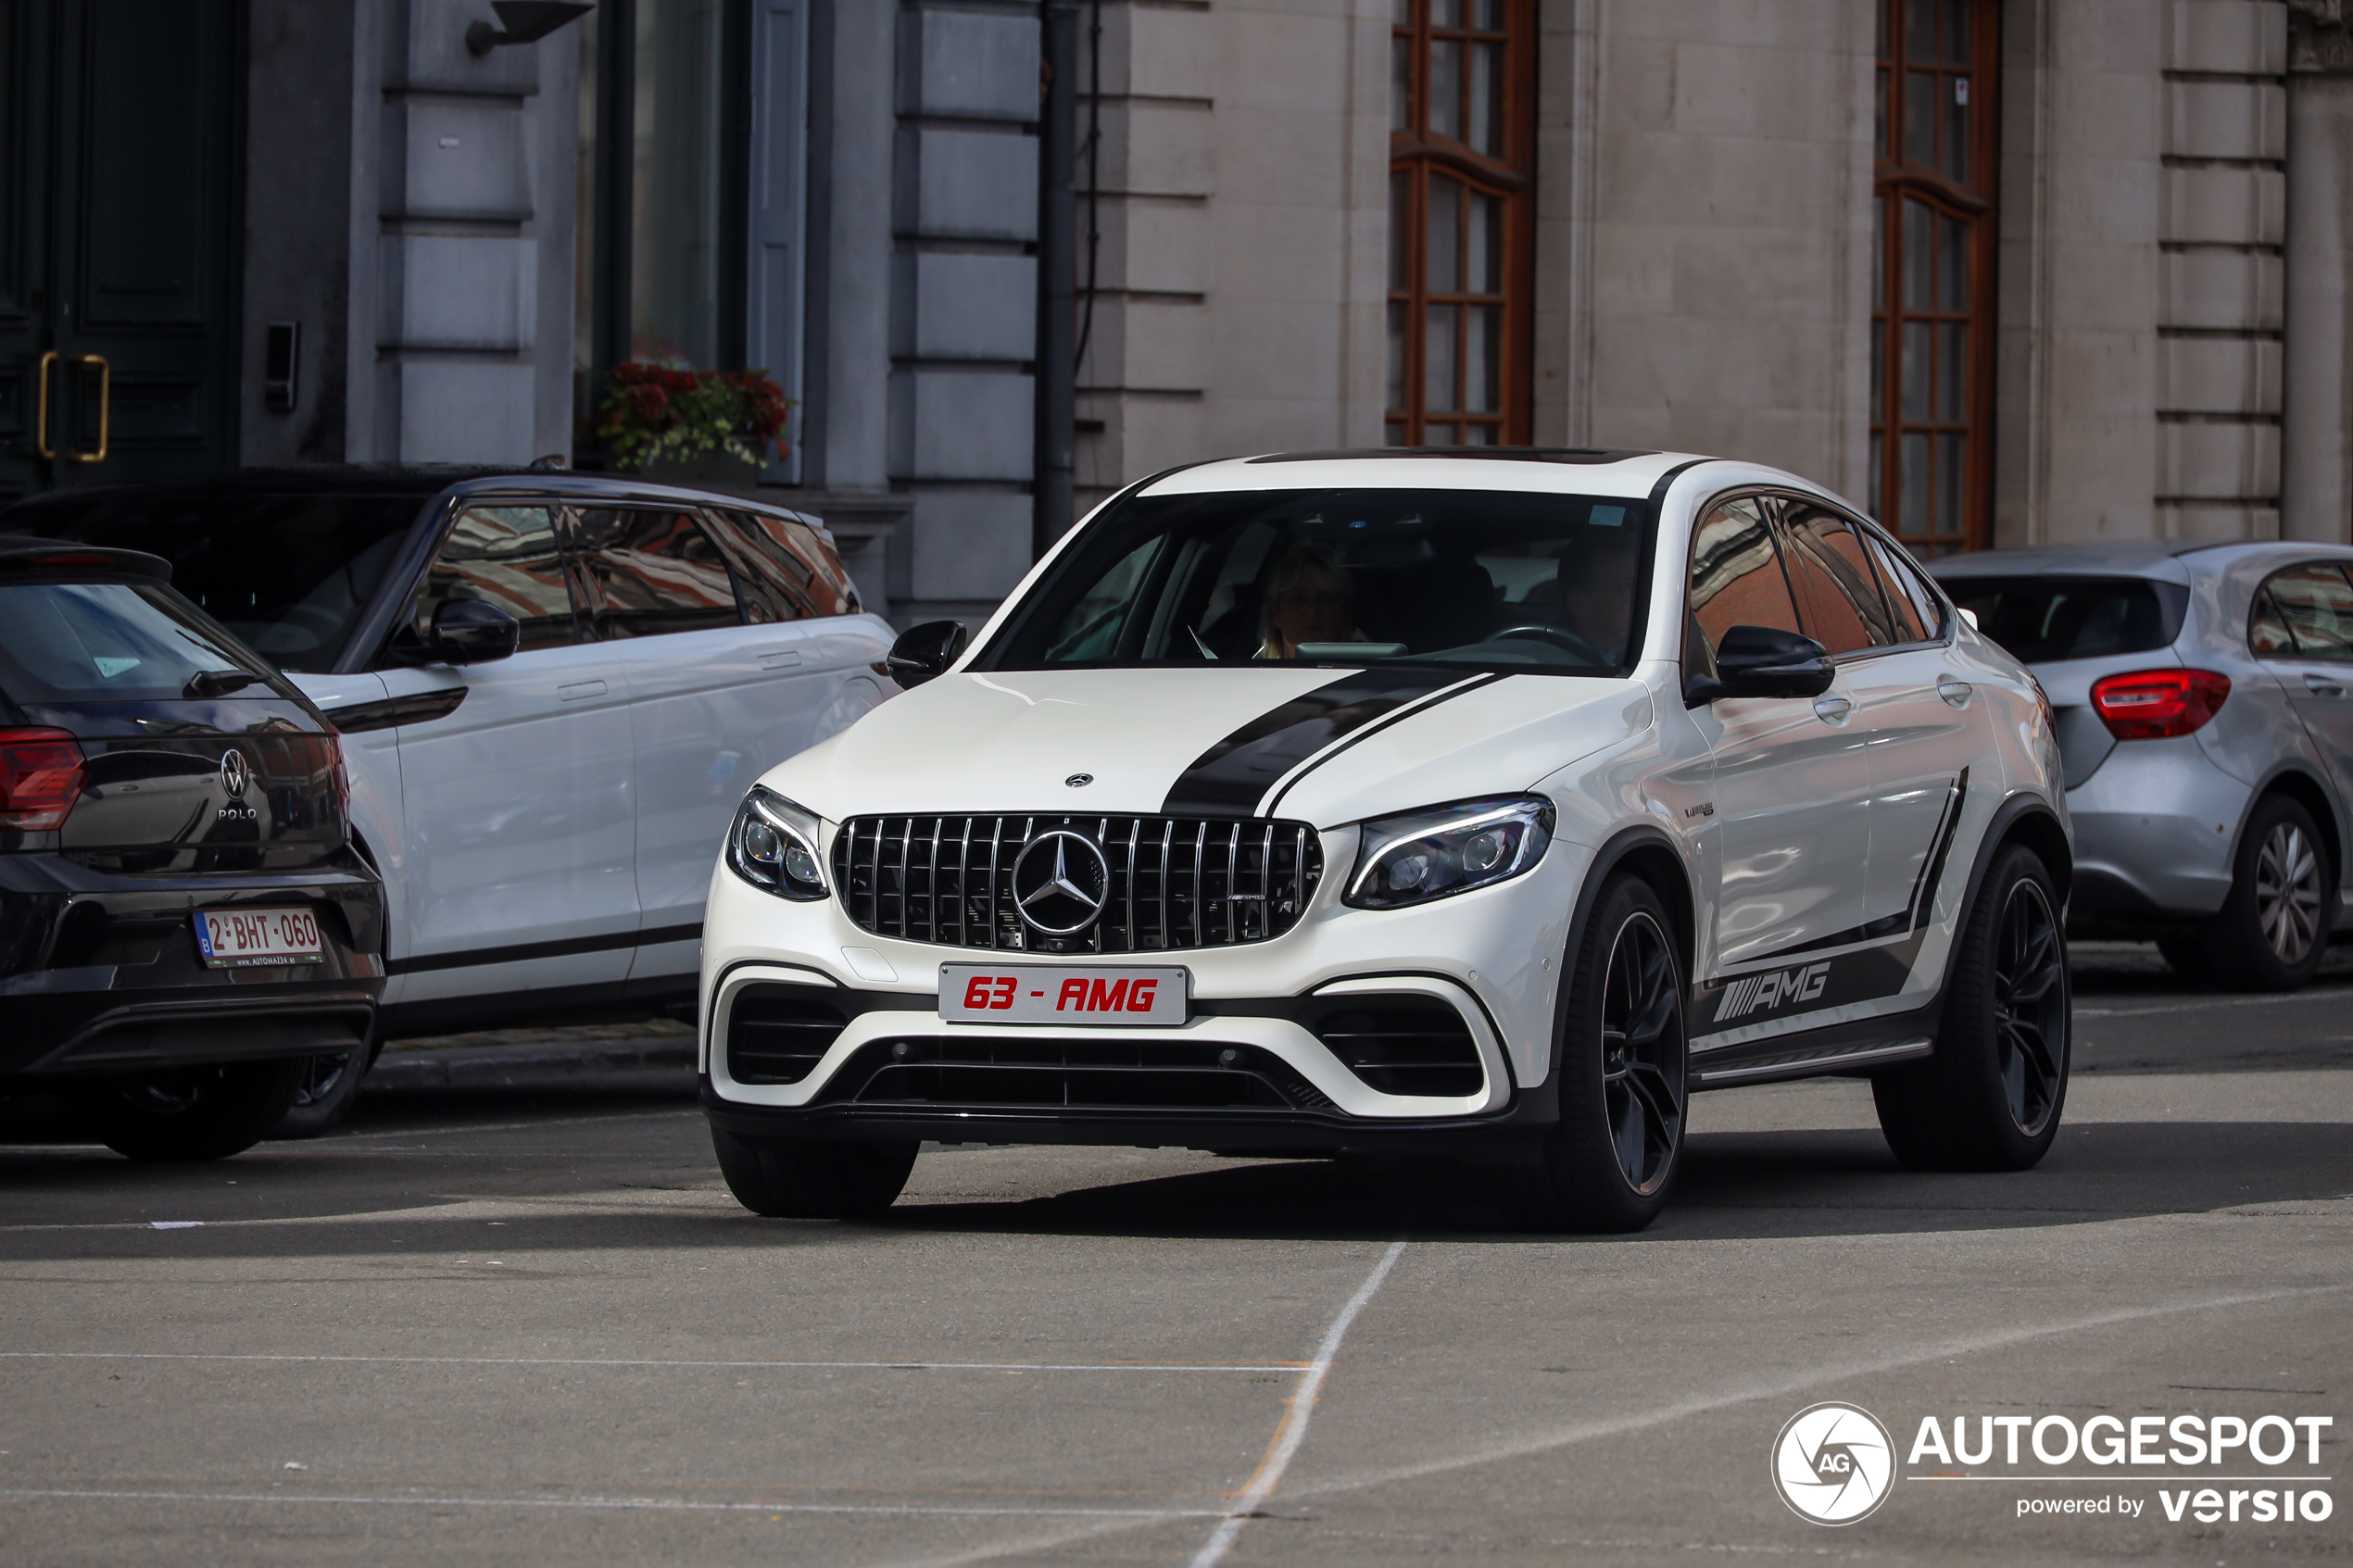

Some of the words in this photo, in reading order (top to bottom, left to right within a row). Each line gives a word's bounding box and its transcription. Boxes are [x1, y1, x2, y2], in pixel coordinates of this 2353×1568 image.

[218, 809, 257, 820] POLO
[201, 938, 210, 953] B
[963, 976, 1018, 1010] 63
[1056, 978, 1158, 1012] AMG
[1745, 961, 1831, 1015] AMG
